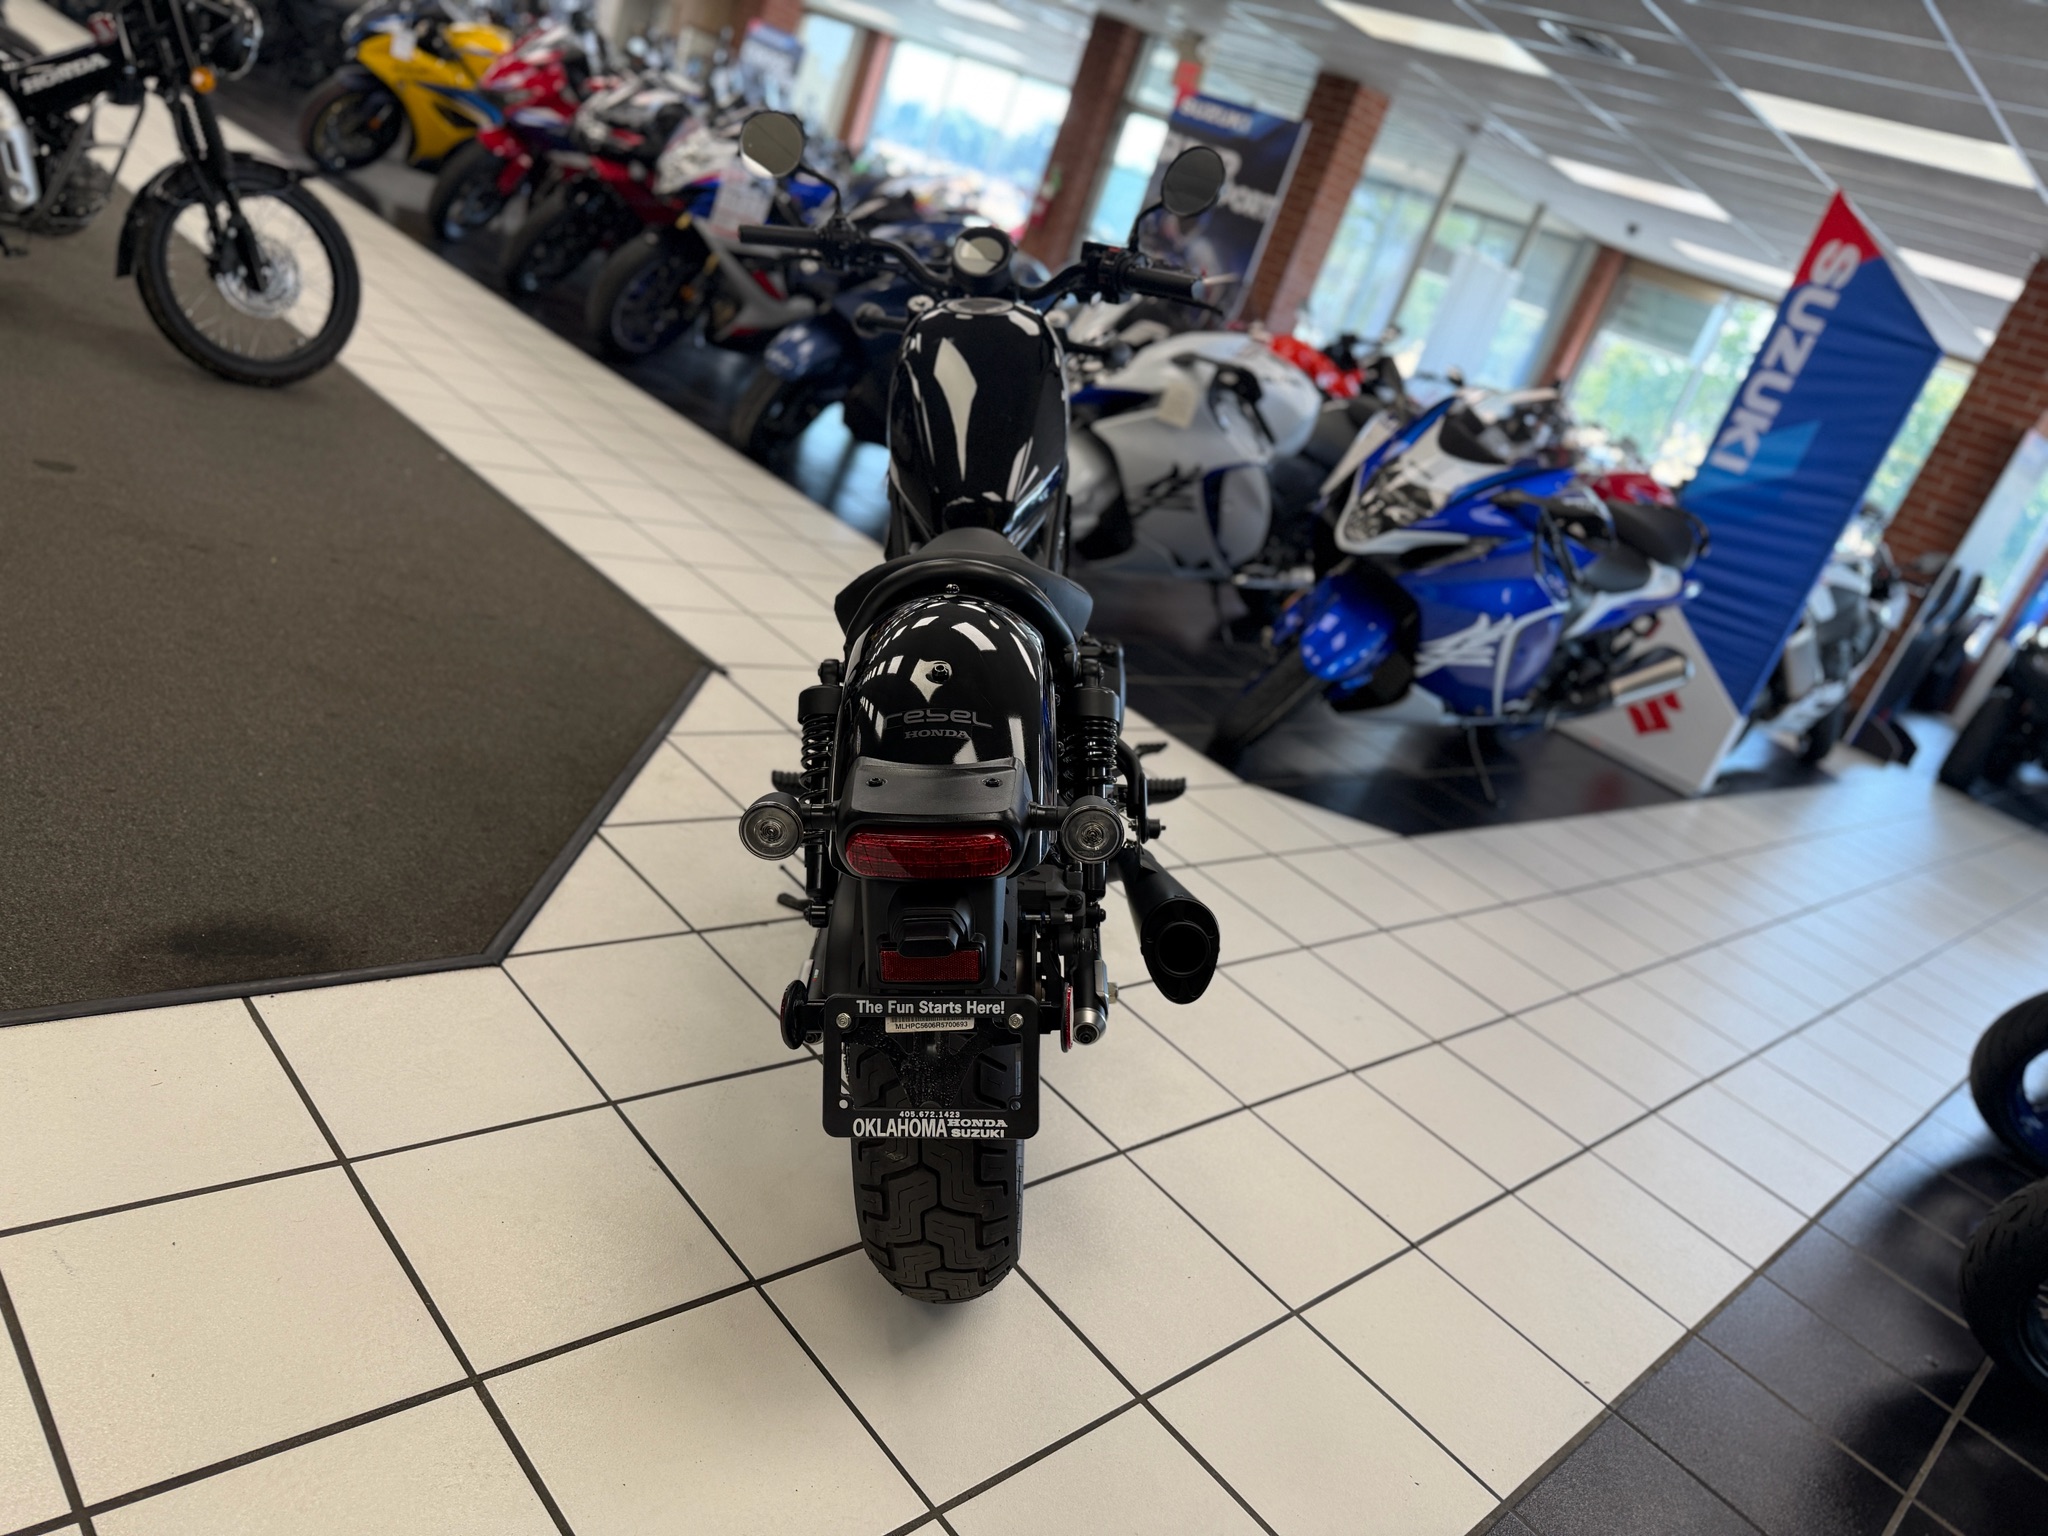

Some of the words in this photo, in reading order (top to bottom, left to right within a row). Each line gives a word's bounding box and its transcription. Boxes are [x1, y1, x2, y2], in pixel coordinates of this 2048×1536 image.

[1709, 238, 1862, 476] SUZUKI
[904, 729, 972, 740] HONDA
[856, 1000, 883, 1014] The
[887, 1000, 914, 1014] Fun
[919, 1000, 962, 1014] Starts
[966, 1001, 1005, 1015] Here!
[852, 1118, 948, 1138] OKLAHOMA
[947, 1118, 1008, 1128] HONDA
[951, 1128, 1005, 1138] SUZUKI
